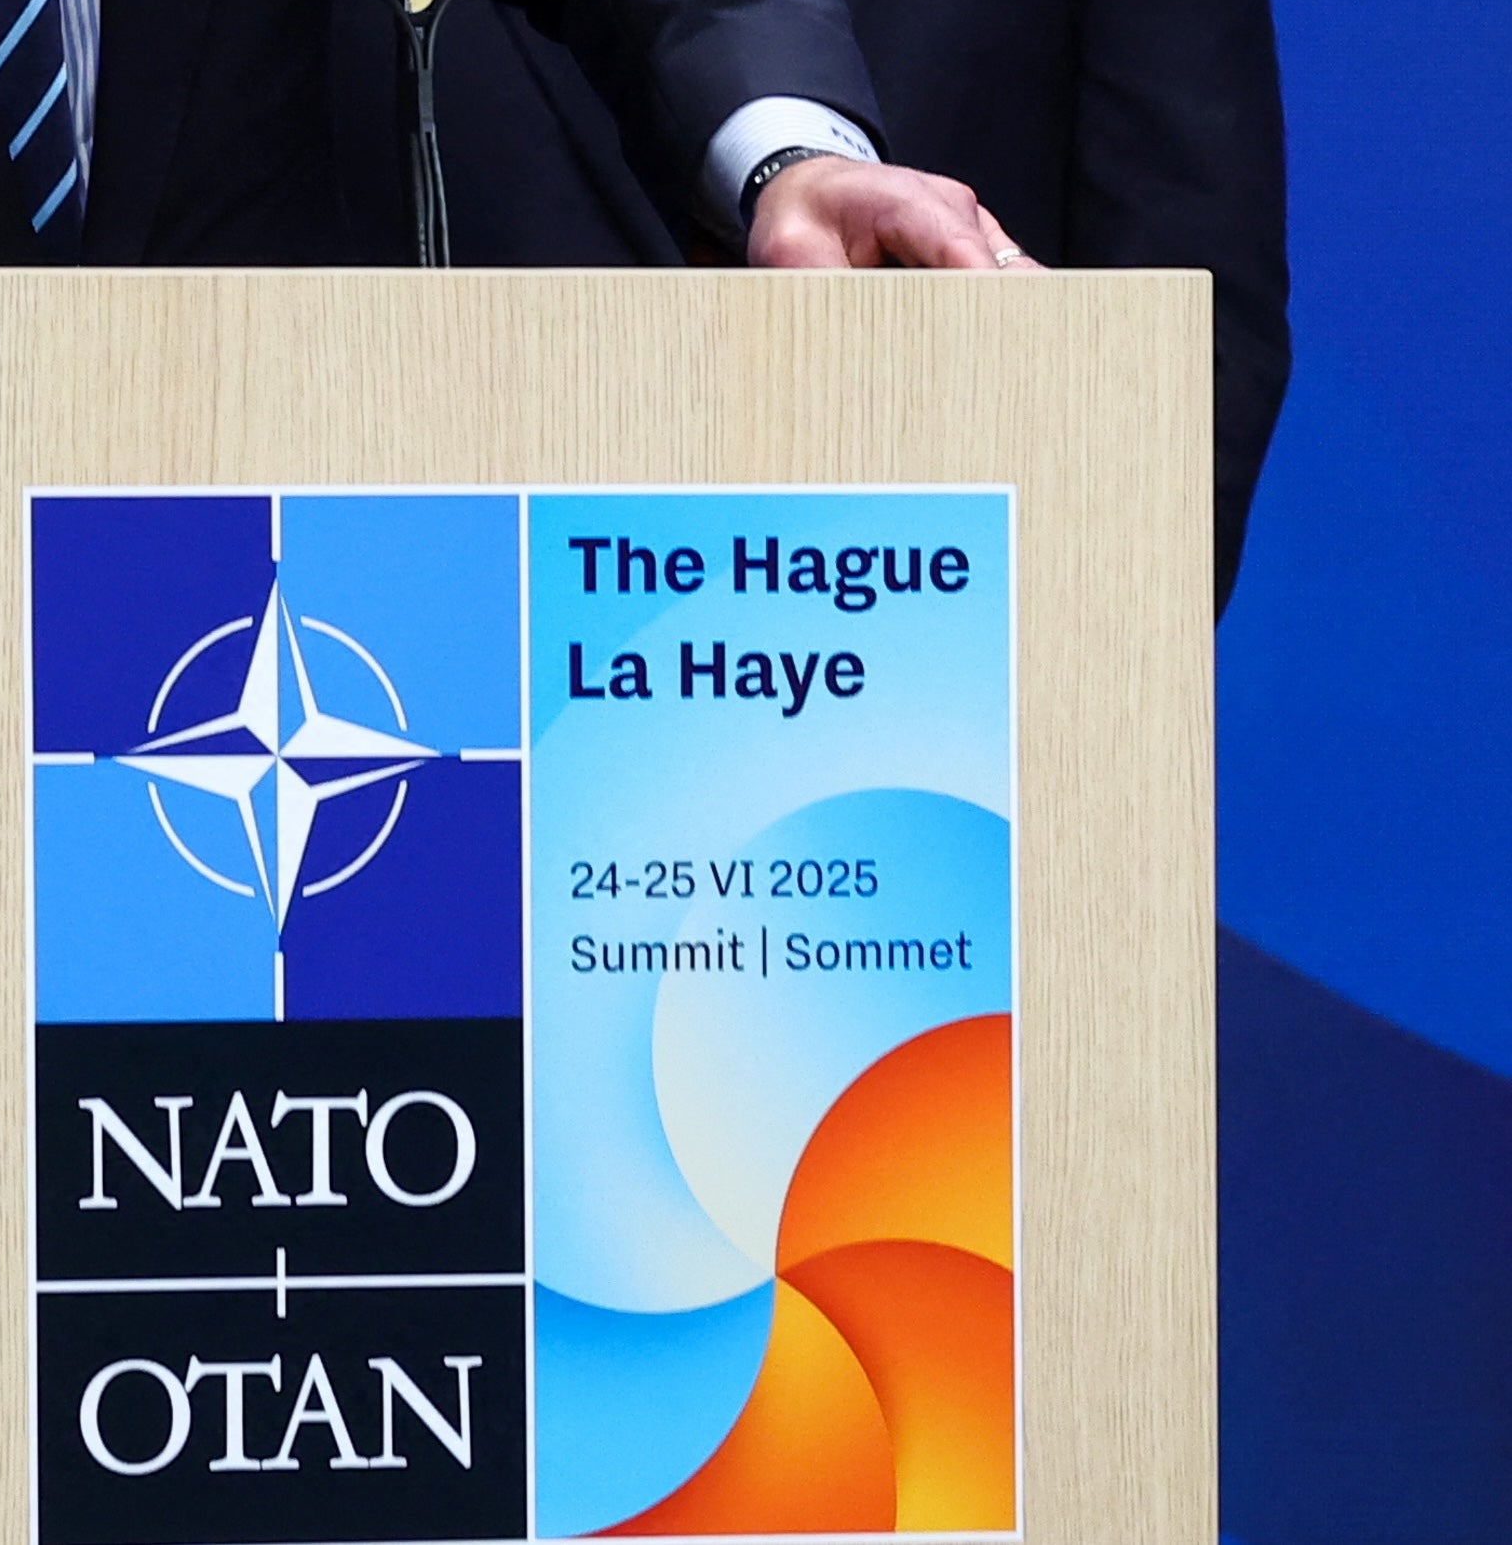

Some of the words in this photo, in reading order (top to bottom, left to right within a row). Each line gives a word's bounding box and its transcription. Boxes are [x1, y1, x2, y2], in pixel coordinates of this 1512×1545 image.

[567, 536, 706, 594] The
[732, 536, 970, 613] Hague
[568, 641, 653, 700] La
[679, 641, 866, 718] Haye
[570, 861, 696, 899] 24-25
[709, 861, 755, 898] VI
[769, 860, 879, 898] 2025
[571, 928, 745, 973] Summit
[784, 931, 974, 971] Sommet
[78, 1088, 477, 1211] NATO
[78, 1353, 484, 1476] OTAN
